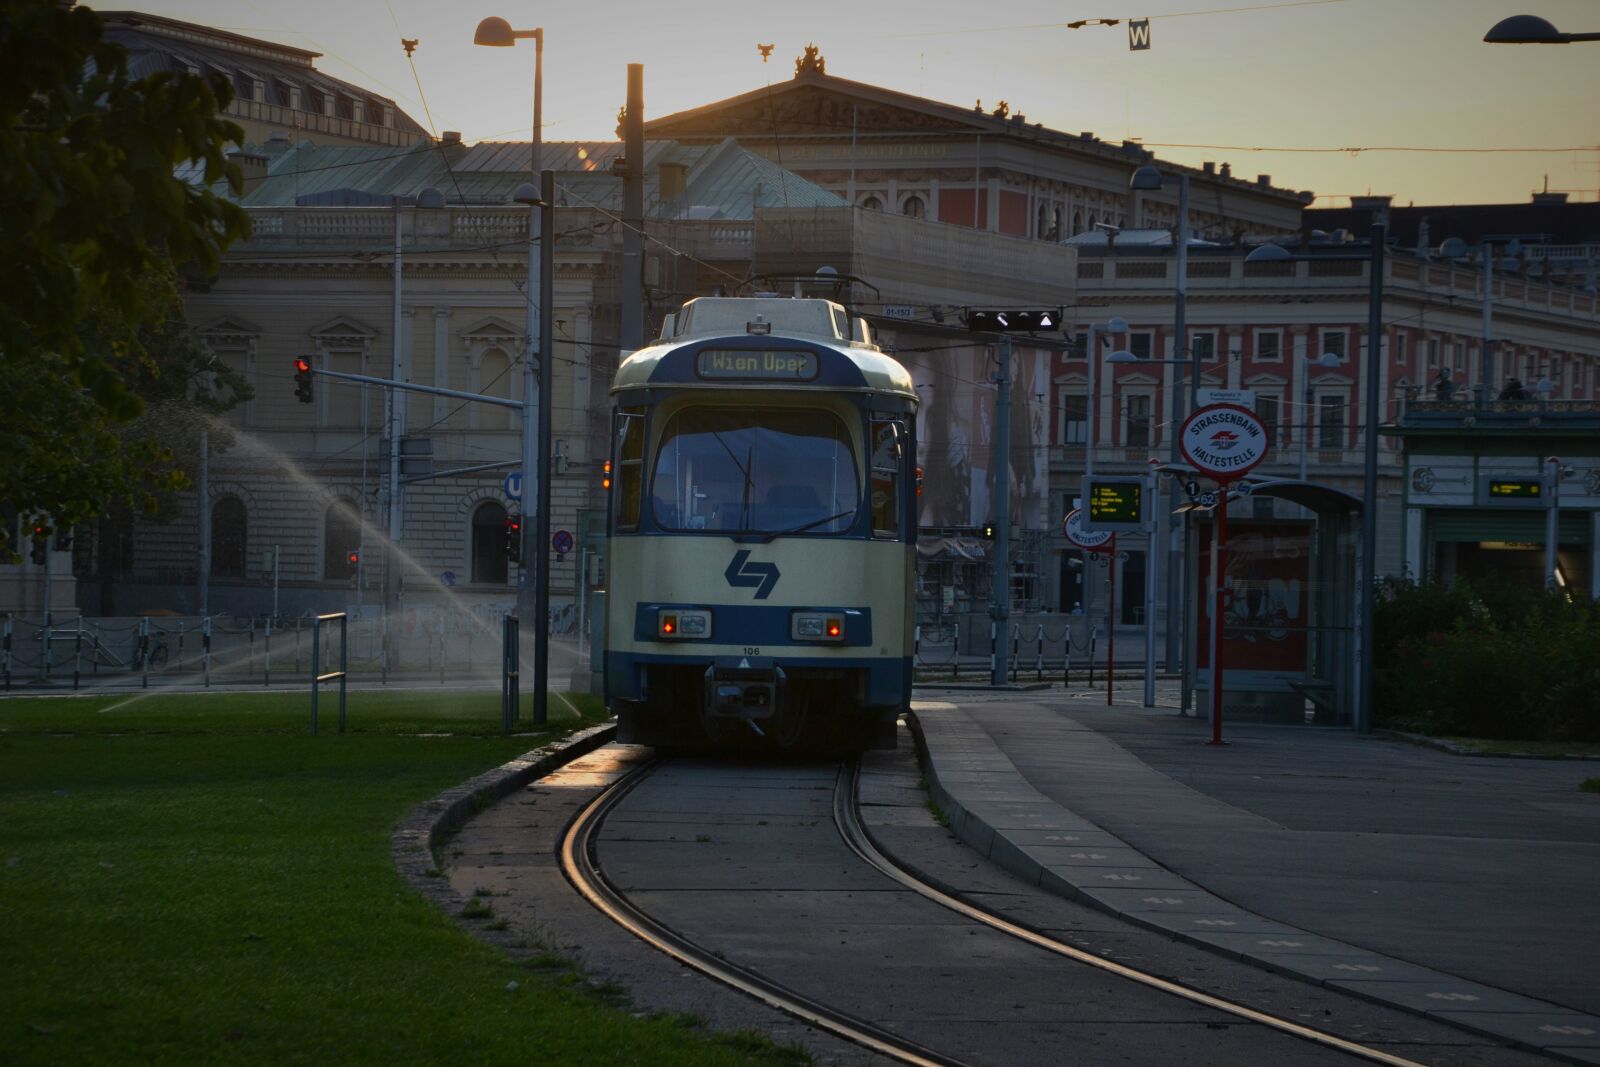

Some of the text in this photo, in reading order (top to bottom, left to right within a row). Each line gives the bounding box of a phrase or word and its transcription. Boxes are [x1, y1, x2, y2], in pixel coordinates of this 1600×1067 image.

[1130, 25, 1149, 46] W
[712, 350, 757, 371] Wien
[1191, 413, 1260, 438] STRASSENBAHN
[1192, 446, 1256, 467] HALTESTELLE
[509, 478, 522, 497] U
[1188, 483, 1195, 495] 1
[1200, 494, 1215, 504] 62
[743, 647, 760, 656] 106
